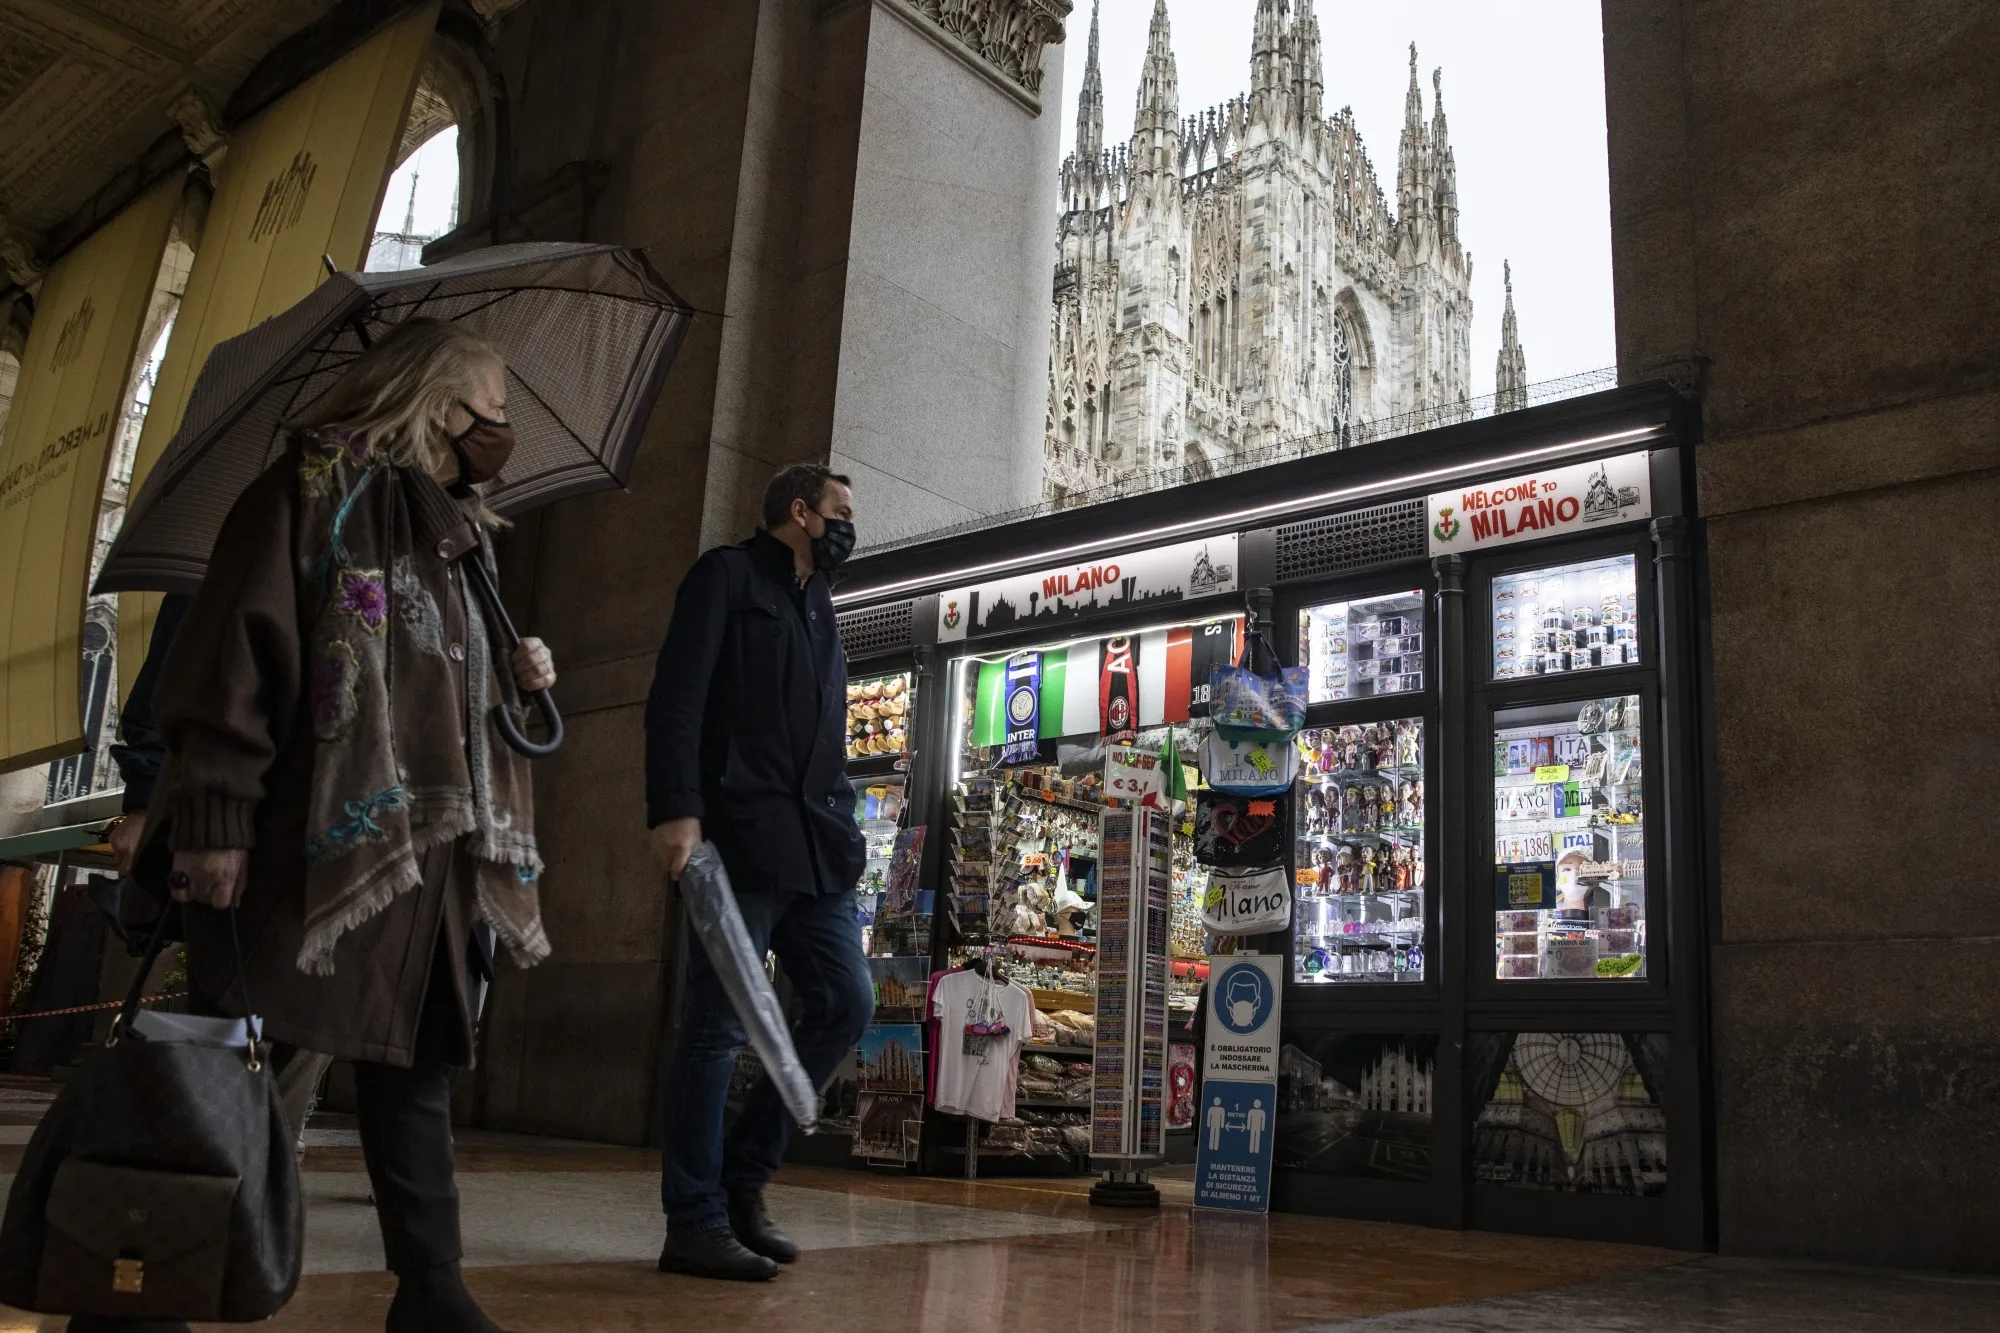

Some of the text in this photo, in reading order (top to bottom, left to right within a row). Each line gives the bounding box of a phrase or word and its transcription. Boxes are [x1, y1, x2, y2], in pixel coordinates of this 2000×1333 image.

[1461, 479, 1558, 512] WELCOME TO
[1469, 496, 1580, 542] MILANO
[1042, 564, 1121, 600] MILANO
[1007, 728, 1036, 743] INTER
[1559, 738, 1588, 755] ITA
[1112, 752, 1123, 764] NO
[1234, 754, 1240, 767] I
[1219, 769, 1279, 782] MILANO
[1112, 778, 1149, 796] € 3,
[1524, 836, 1549, 857] 1386
[1563, 834, 1593, 848] ITAL
[1210, 1043, 1272, 1054] È OBBLIGATORIO
[1219, 1054, 1262, 1063] INDOSSARE
[1210, 1062, 1270, 1072] LA MASCHERINA
[1234, 1103, 1239, 1111] 1
[1210, 1163, 1256, 1174] MANTENERE
[1208, 1172, 1256, 1183] LA DISTANZA
[1205, 1181, 1257, 1193] DI SICUREZZA
[1200, 1190, 1209, 1198] DI
[1210, 1191, 1241, 1201] ALMENO
[1249, 1195, 1261, 1203] MT
